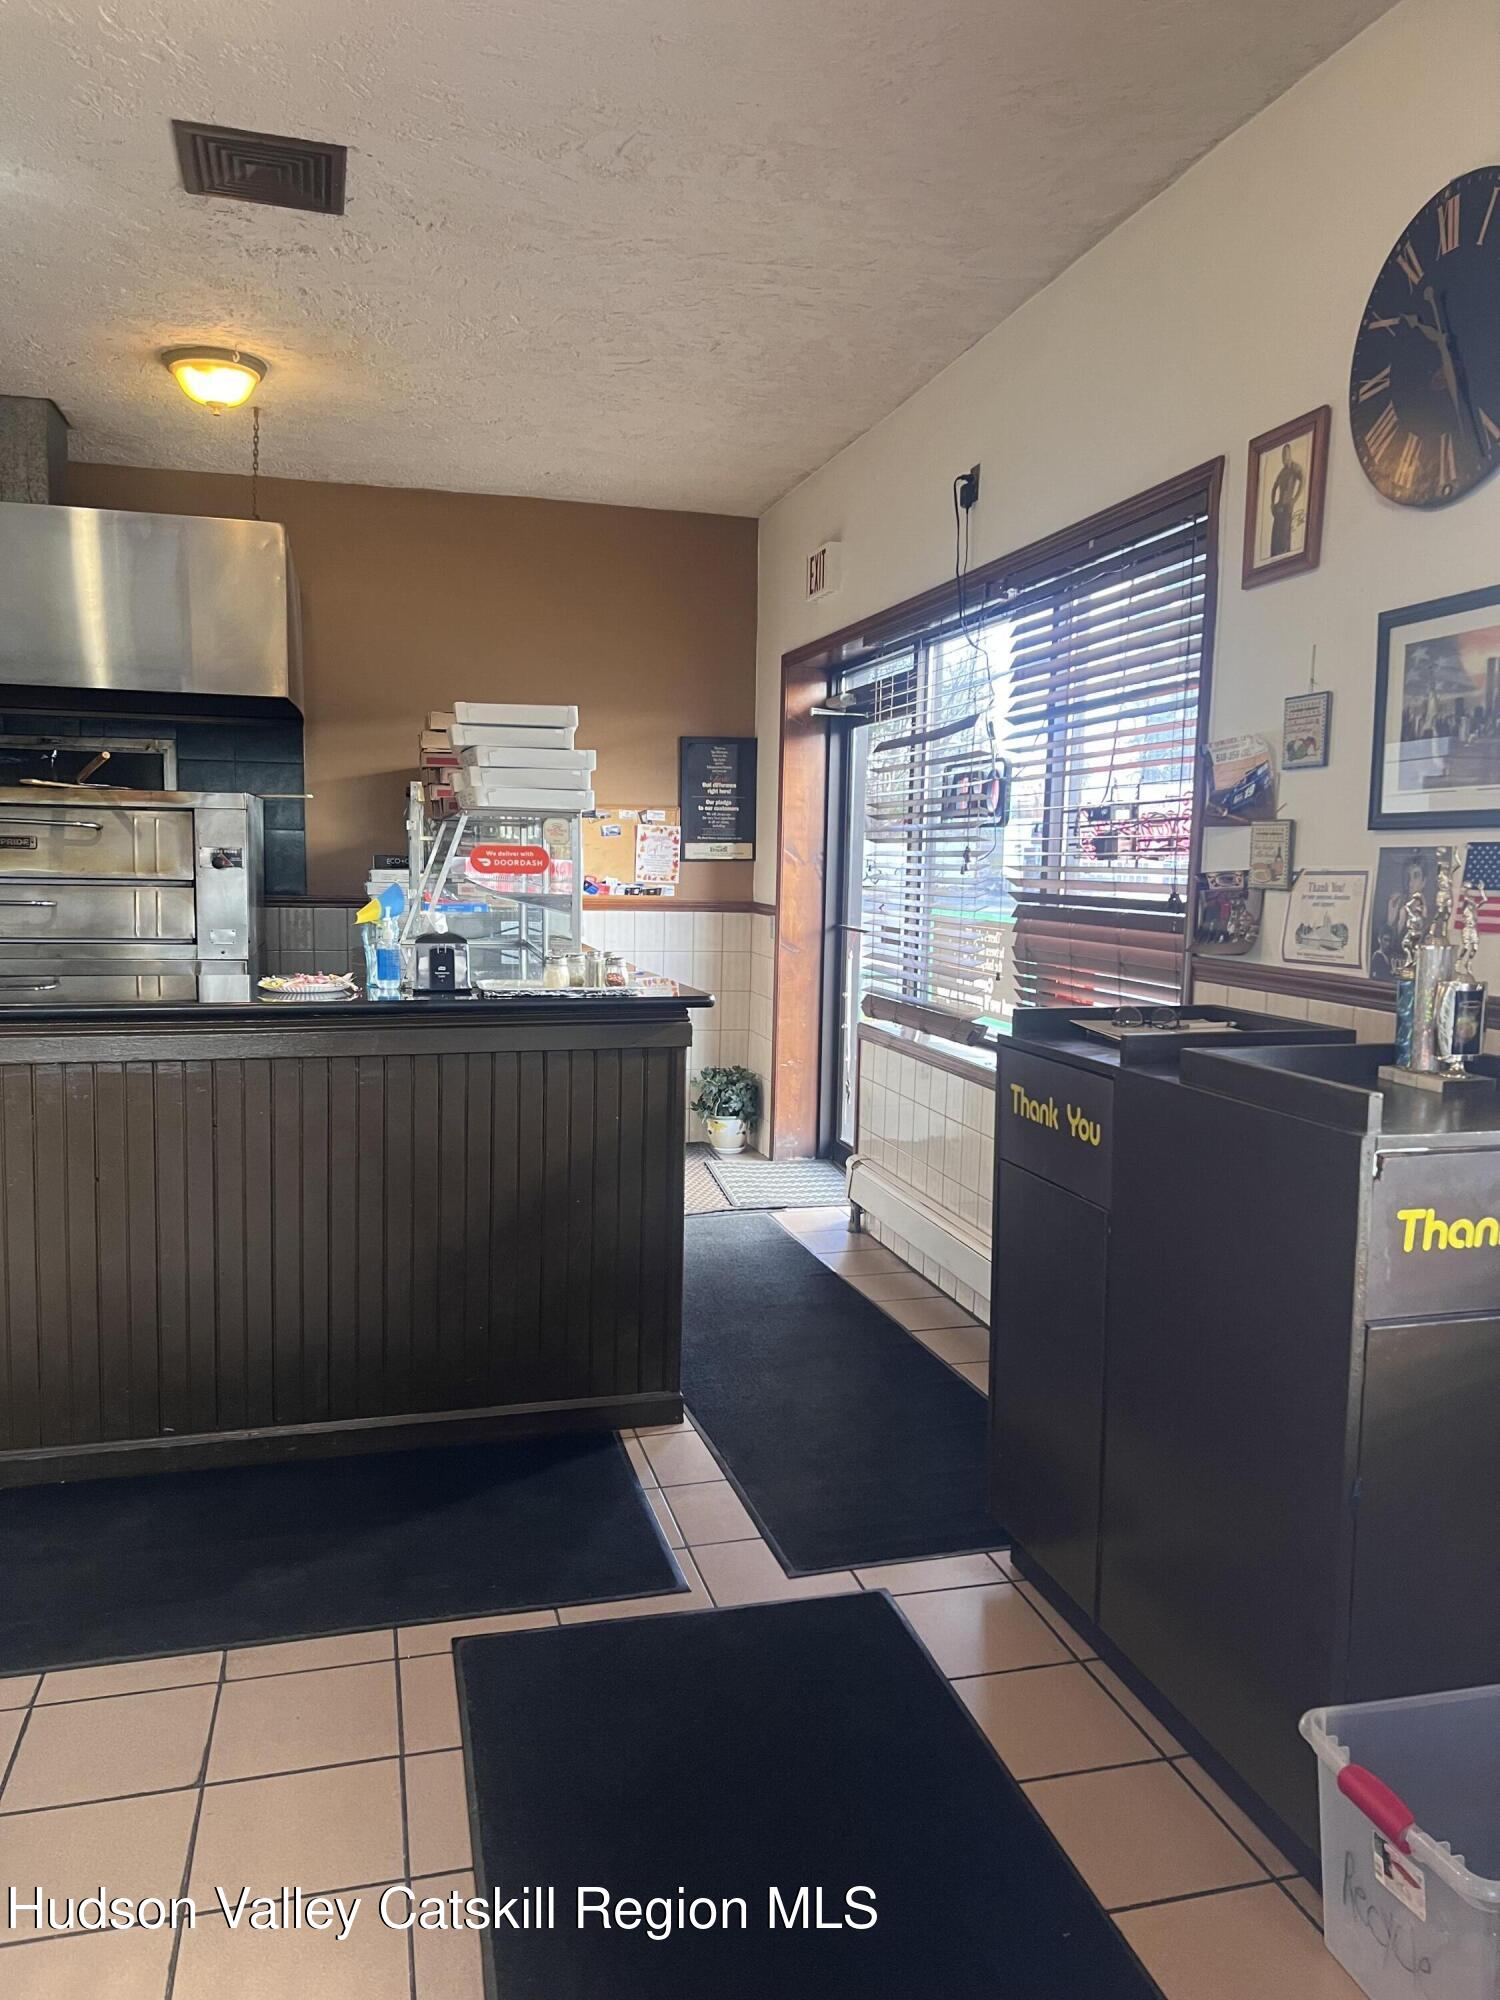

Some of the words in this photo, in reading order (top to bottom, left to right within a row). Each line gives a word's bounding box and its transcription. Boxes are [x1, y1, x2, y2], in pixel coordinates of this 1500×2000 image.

[809, 548, 826, 595] EXIT
[494, 859, 543, 867] DOORDASH
[1010, 1083, 1059, 1130] Thank
[1066, 1103, 1101, 1147] You
[1396, 1208, 1500, 1253] Than
